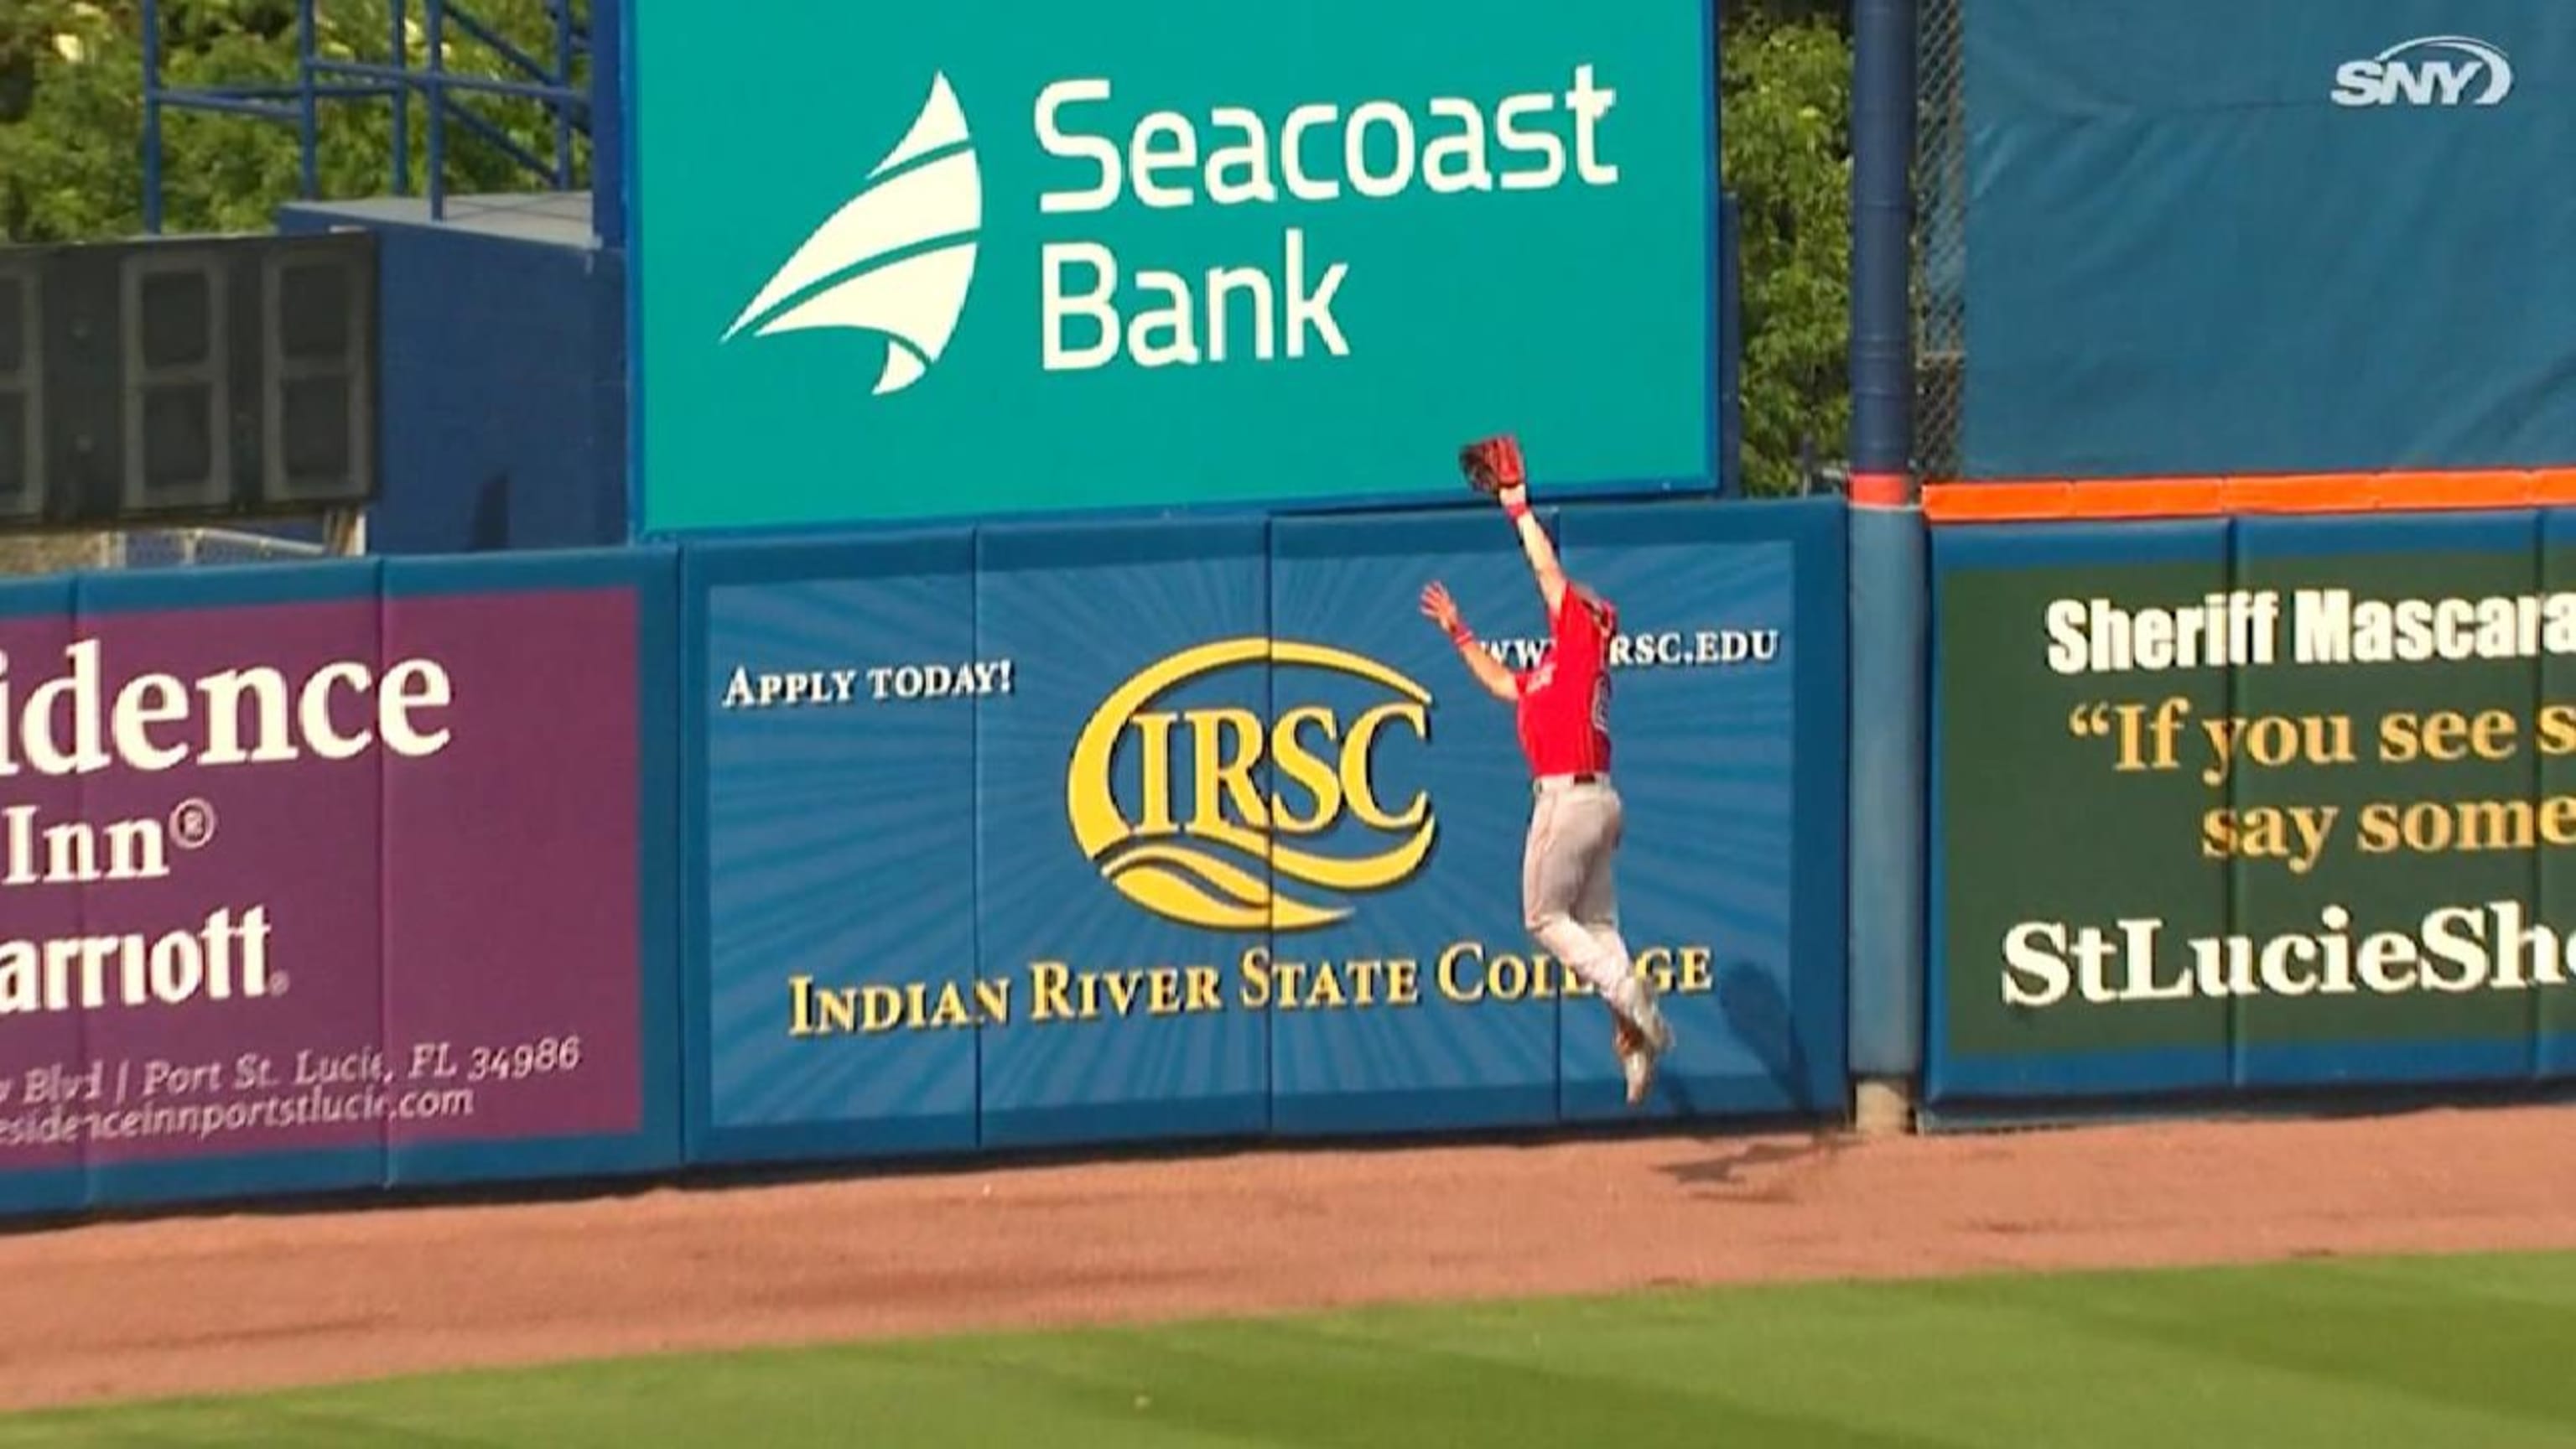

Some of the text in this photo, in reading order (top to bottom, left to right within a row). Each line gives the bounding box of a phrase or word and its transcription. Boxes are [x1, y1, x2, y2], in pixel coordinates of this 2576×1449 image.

[1034, 65, 1618, 213] Seacoast
[1042, 228, 1350, 371] Bank
[1479, 629, 1779, 671] WWRSC.EDU
[2047, 589, 2576, 673] Sheriff Mascara
[0, 638, 451, 776] idence
[722, 660, 1011, 707] APPLY TODAY!
[1130, 705, 1427, 833] IRSC
[2202, 714, 2356, 787] you
[2379, 708, 2517, 762] see
[2201, 794, 2576, 875] say some
[789, 941, 1713, 1036] INDIAN RIVER STATE COLLGE
[2002, 899, 2576, 1007] StLucieSh
[143, 1058, 222, 1096] Port
[408, 1042, 458, 1079] FL
[467, 1035, 582, 1082] 34986
